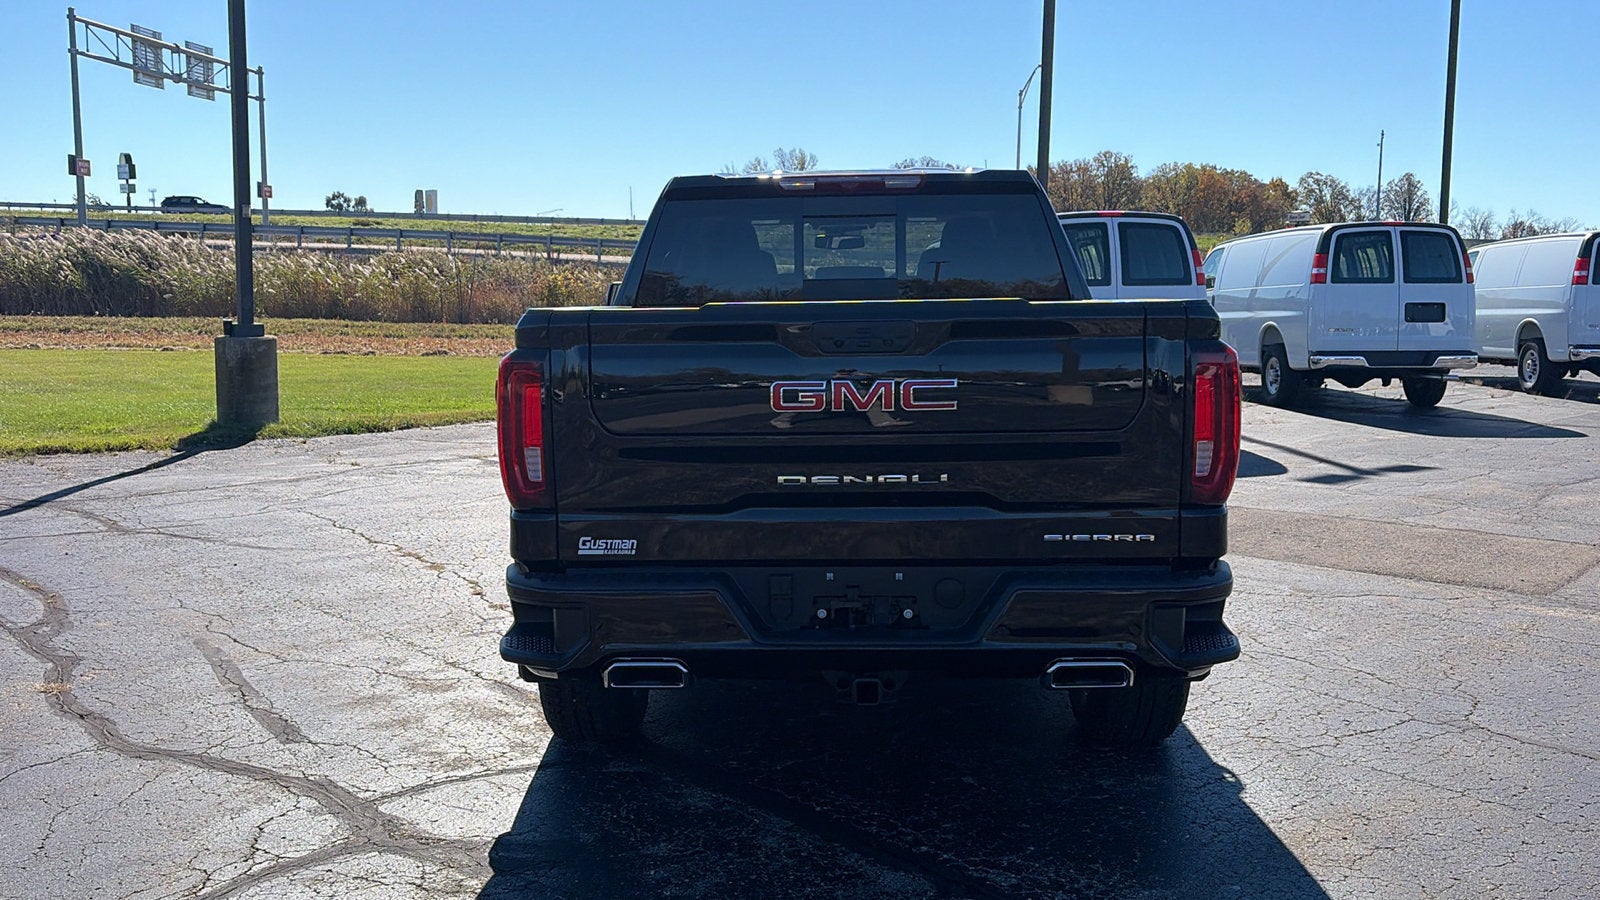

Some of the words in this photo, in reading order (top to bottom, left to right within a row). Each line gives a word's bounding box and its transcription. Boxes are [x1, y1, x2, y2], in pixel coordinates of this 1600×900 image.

[770, 378, 958, 413] GMC
[777, 473, 948, 485] DENALI
[578, 536, 637, 549] Gustman
[1043, 534, 1155, 542] SIERRA
